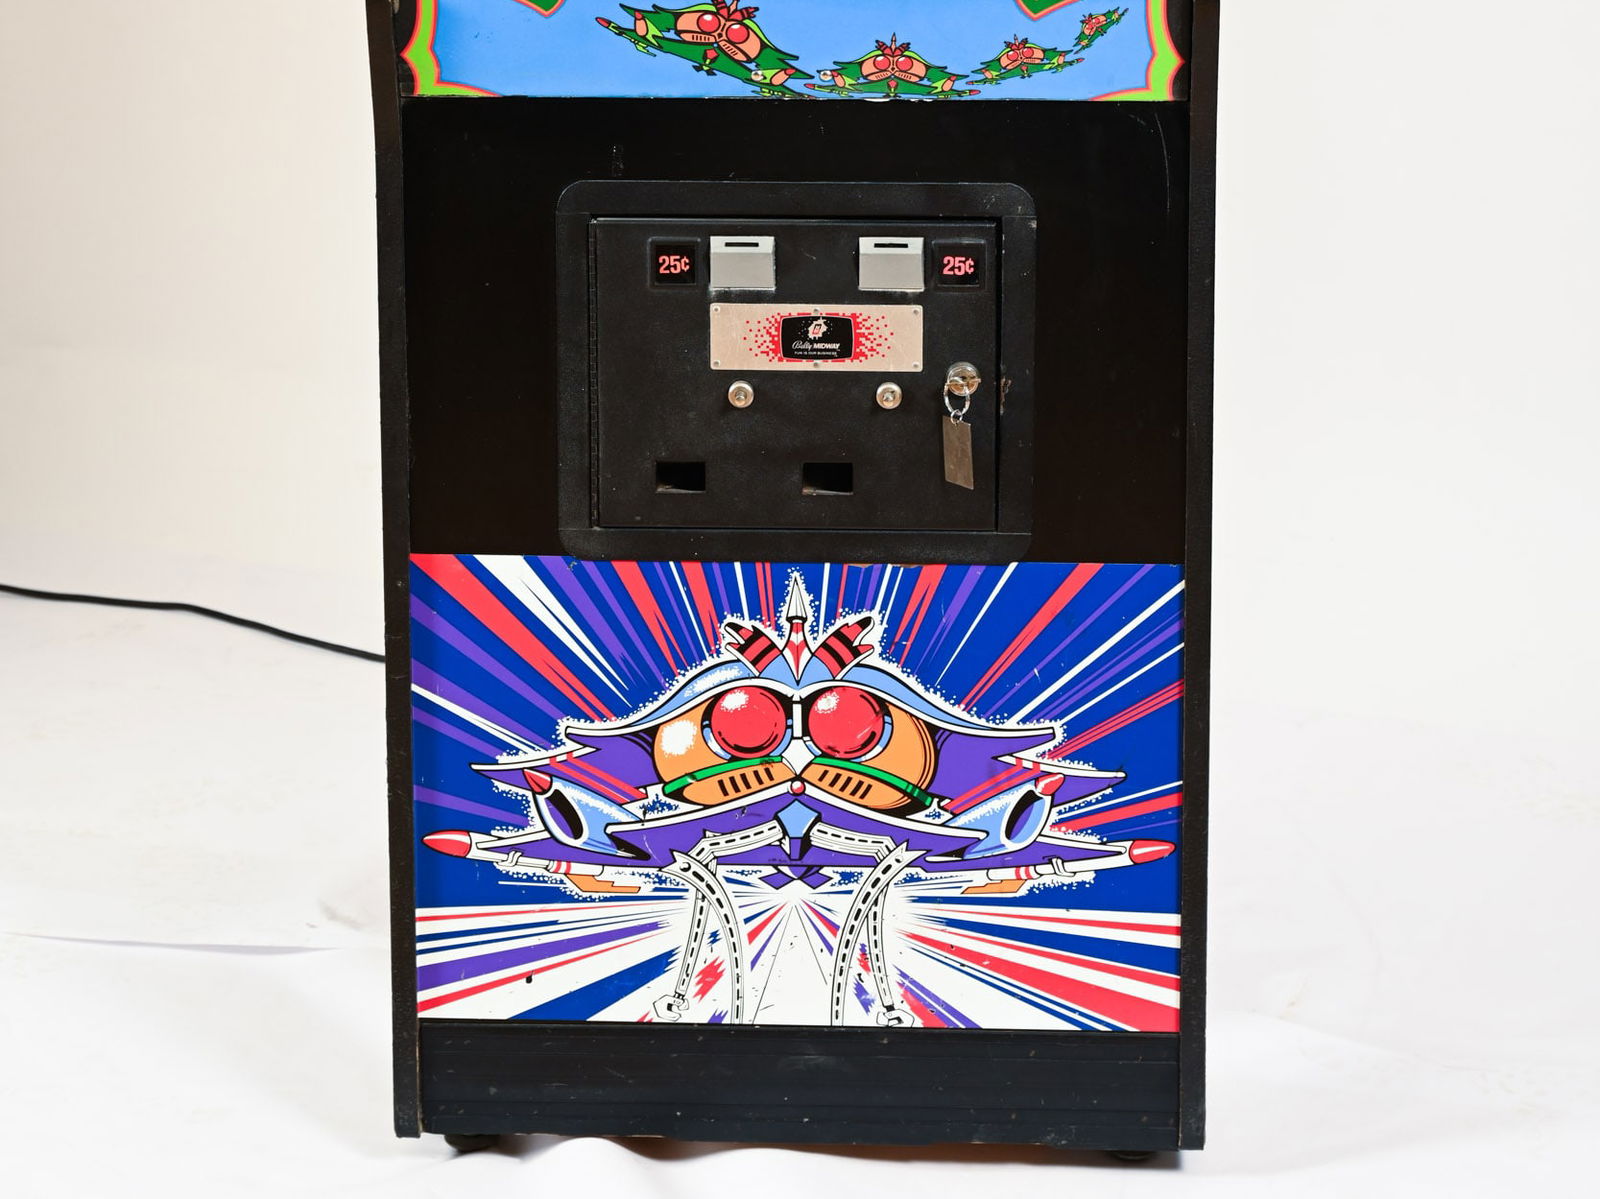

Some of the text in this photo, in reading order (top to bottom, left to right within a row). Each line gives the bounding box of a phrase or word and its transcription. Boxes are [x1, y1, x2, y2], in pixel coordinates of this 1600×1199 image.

[658, 255, 690, 274] 25¢
[943, 256, 974, 276] 25¢
[792, 340, 812, 351] Bally
